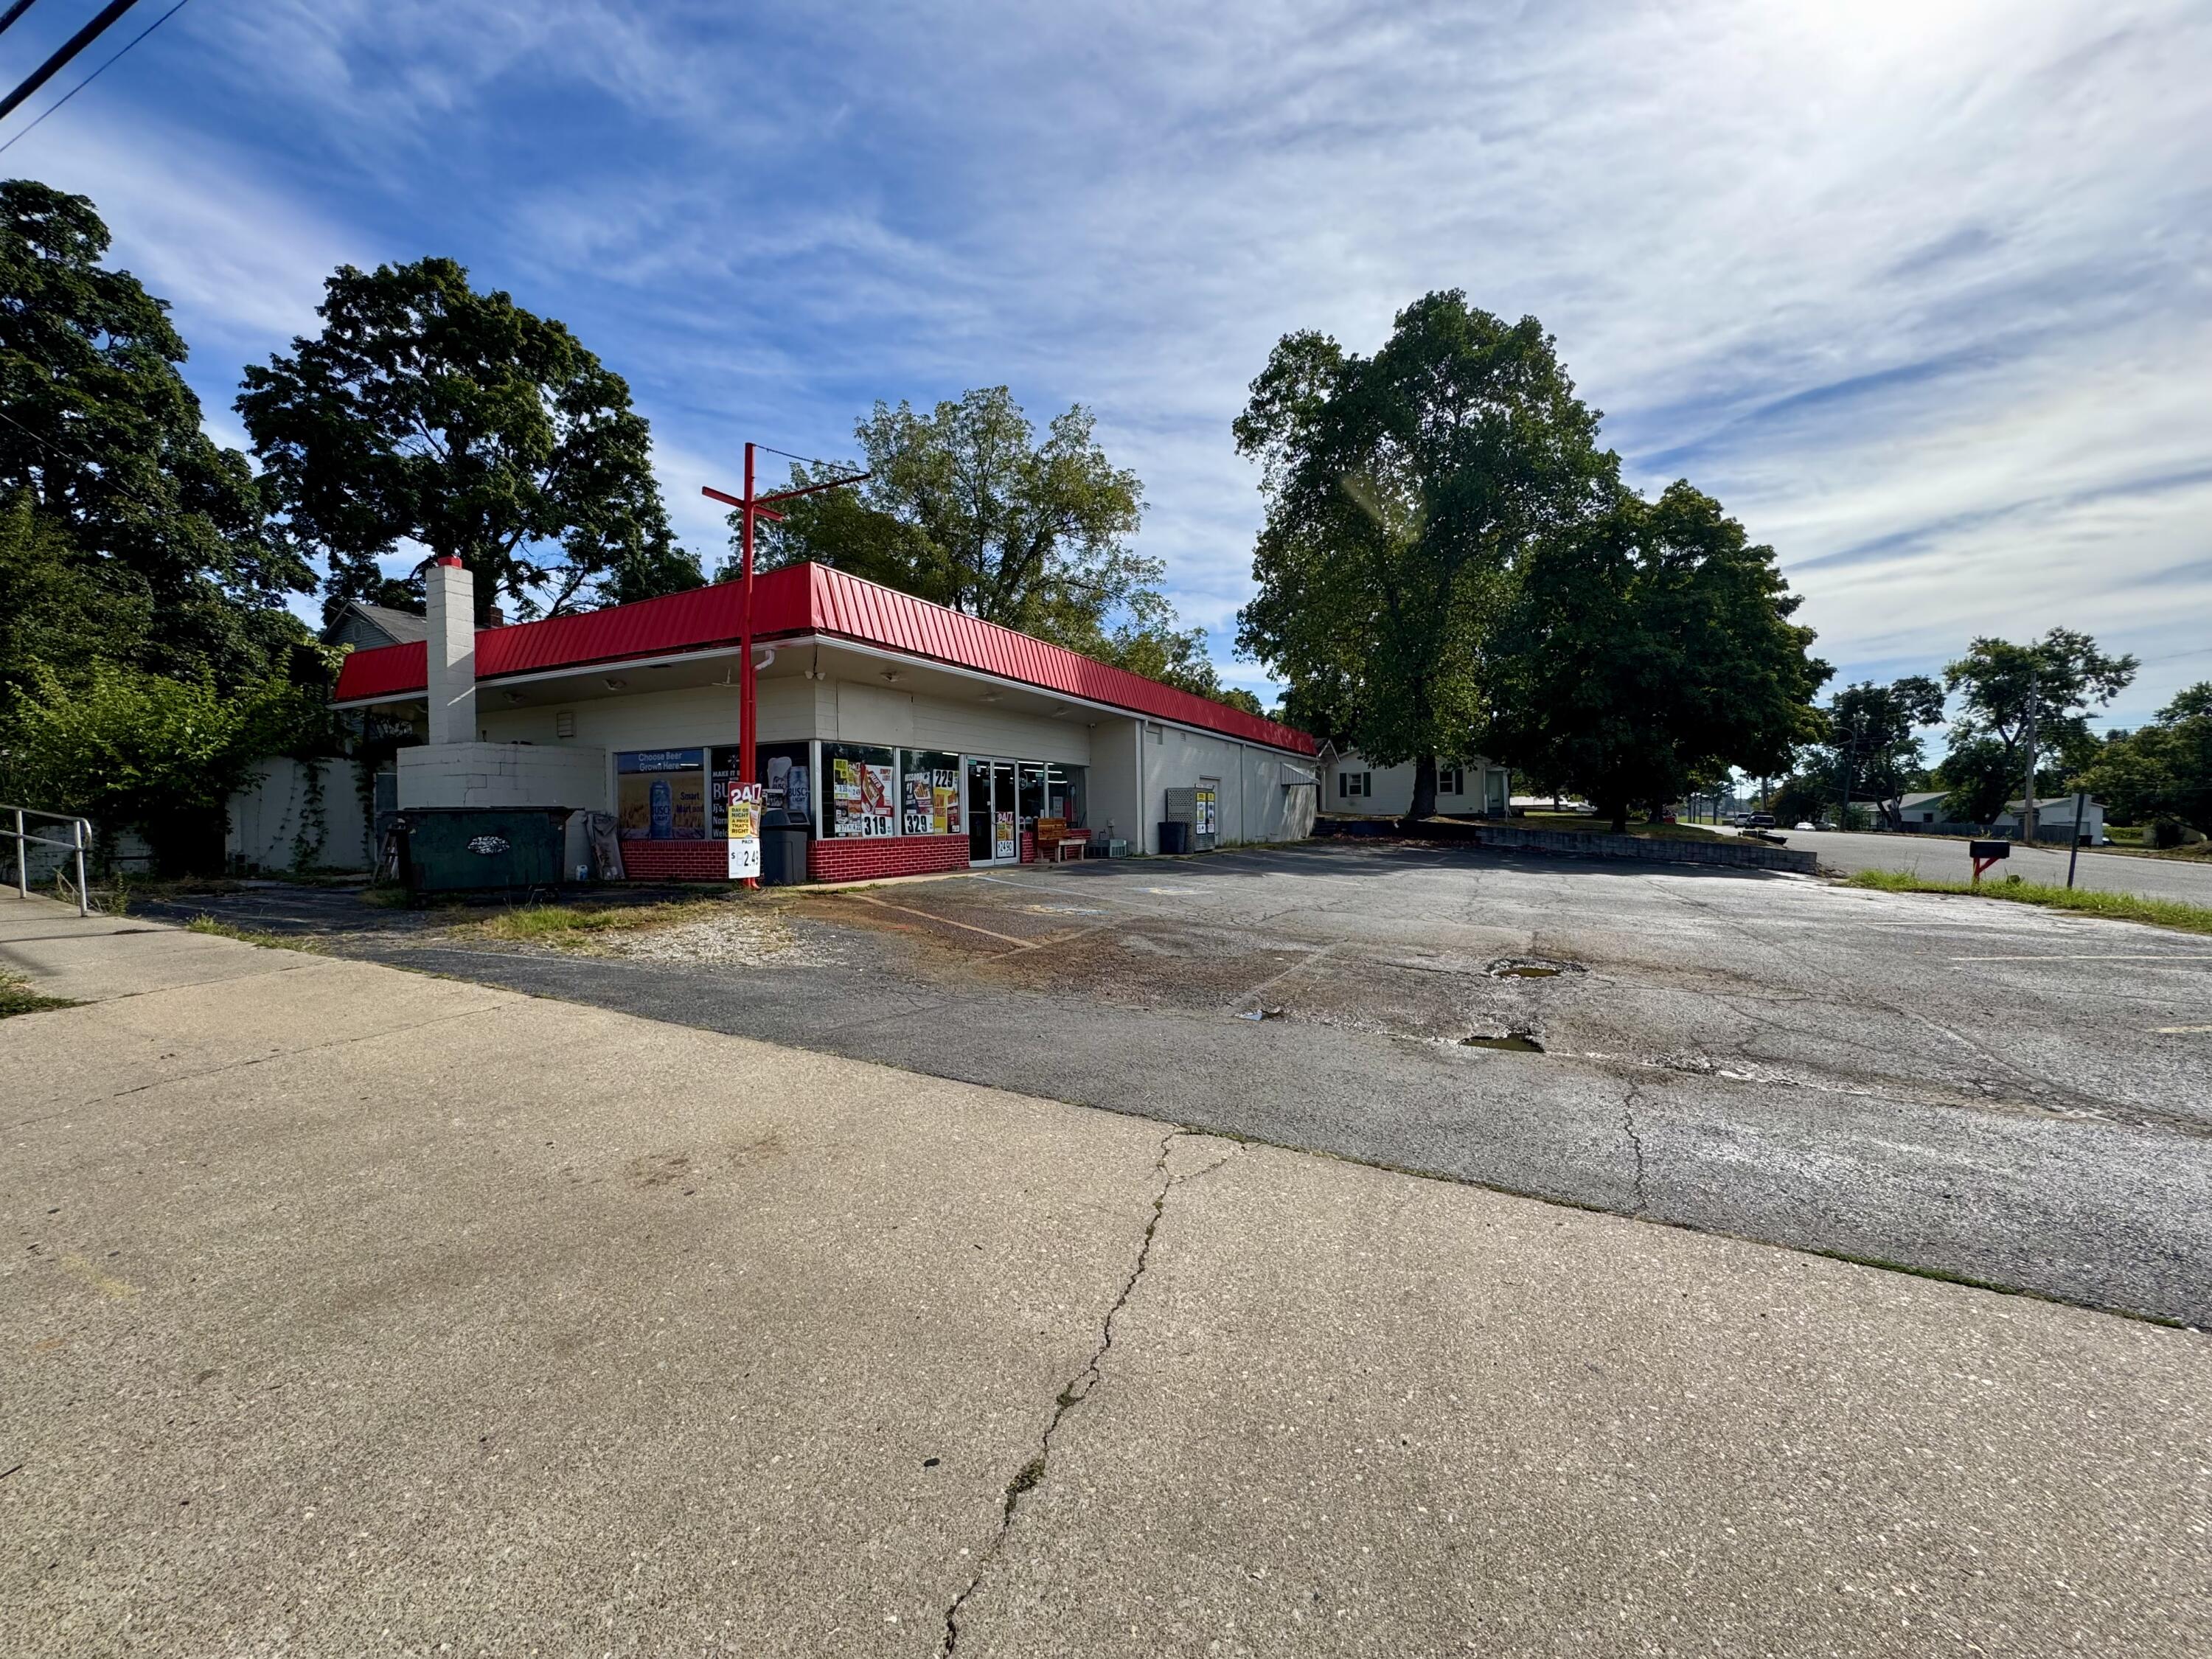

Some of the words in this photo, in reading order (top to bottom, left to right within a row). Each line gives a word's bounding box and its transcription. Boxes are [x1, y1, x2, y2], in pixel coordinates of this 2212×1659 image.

[638, 753, 665, 762] Choose
[666, 751, 683, 760] Beer
[639, 762, 661, 771] Grown
[935, 771, 953, 787] 229
[680, 792, 700, 800] Smart
[788, 787, 810, 797] BUSCH
[676, 804, 691, 814] Mart
[863, 816, 887, 835] 319
[906, 815, 928, 833] 329
[713, 828, 728, 838] Welc
